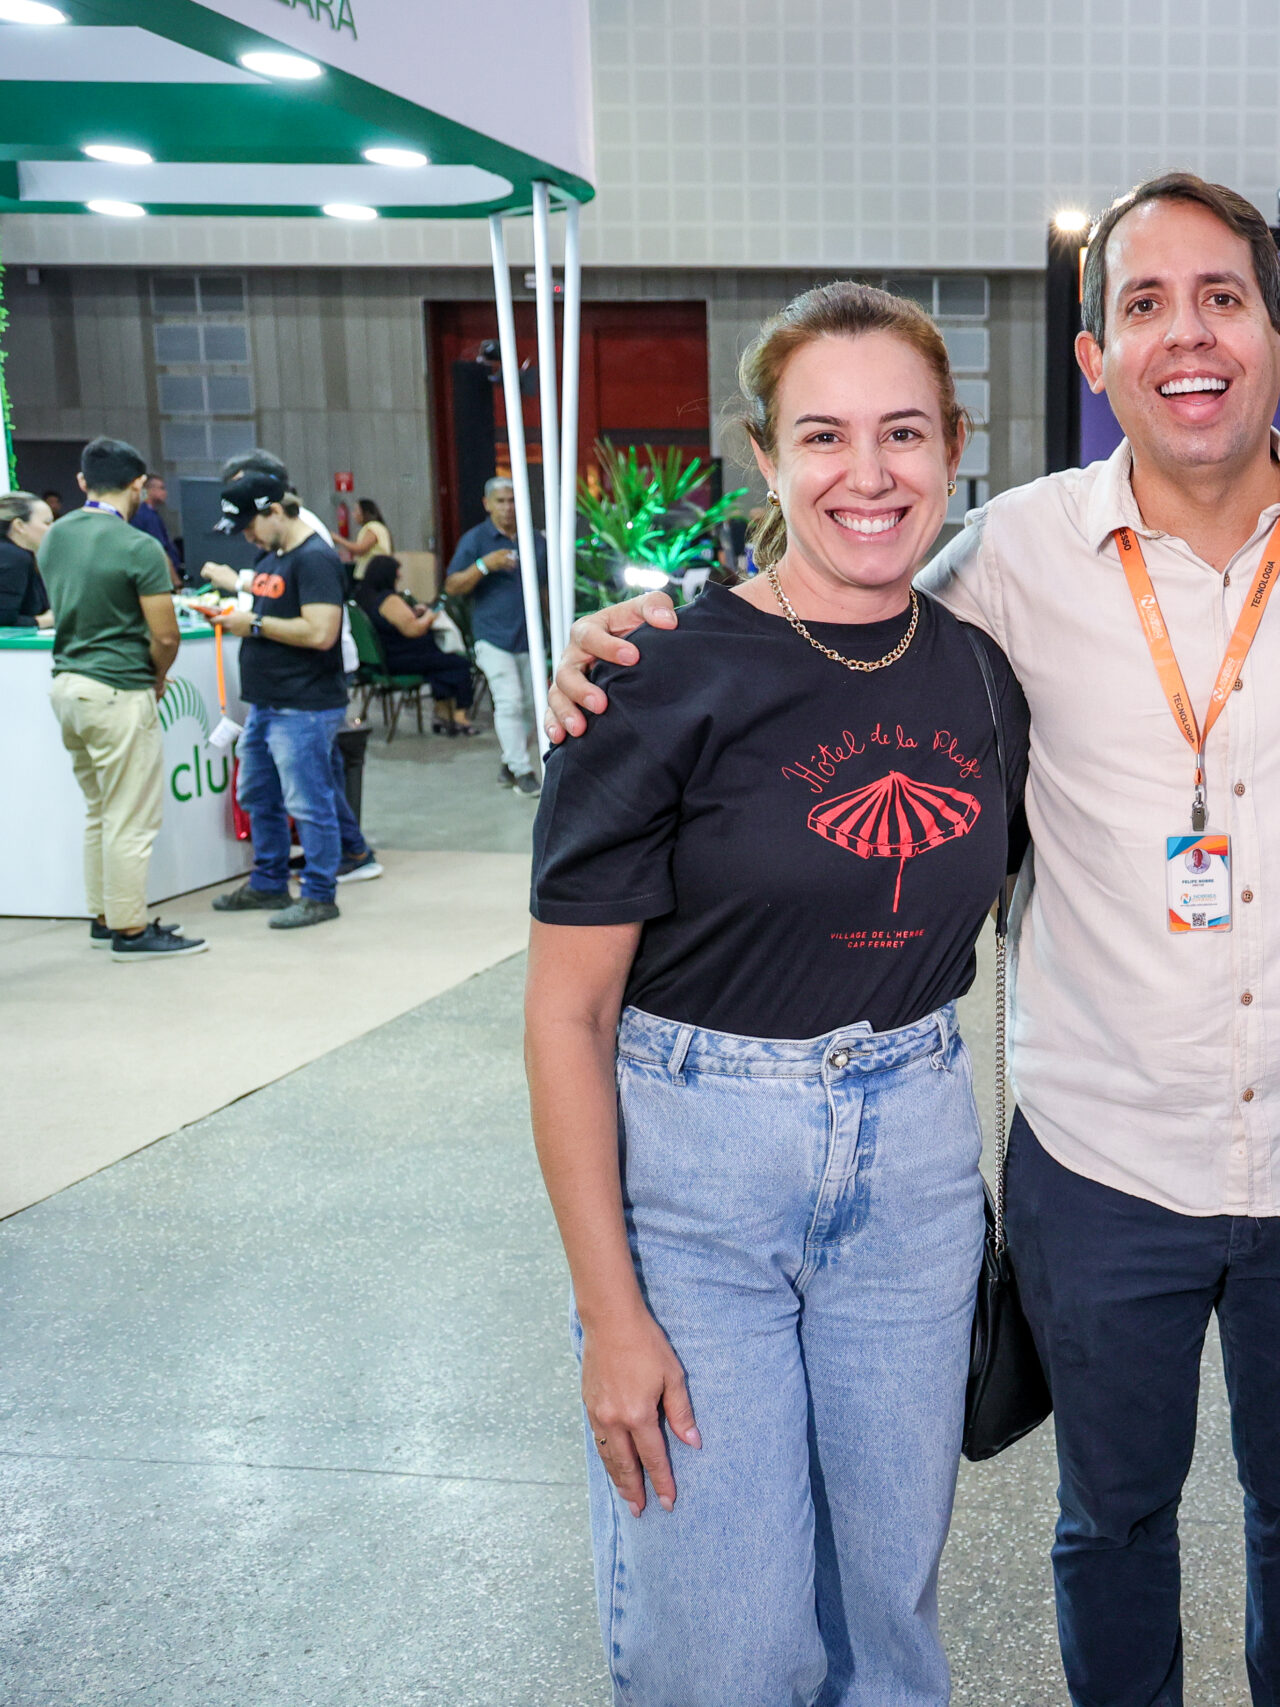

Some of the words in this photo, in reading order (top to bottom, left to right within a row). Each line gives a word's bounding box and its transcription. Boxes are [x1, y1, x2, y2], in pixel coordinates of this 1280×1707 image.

[1250, 560, 1276, 609] TECNOLOGIA
[870, 723, 891, 745] de
[896, 724, 918, 750] la
[1173, 692, 1196, 745] TECNOLOGIA
[171, 740, 236, 803] clu
[829, 931, 868, 940] VILLAGE
[871, 931, 885, 939] DE
[847, 940, 866, 949] CAP
[867, 940, 906, 949] FERRET
